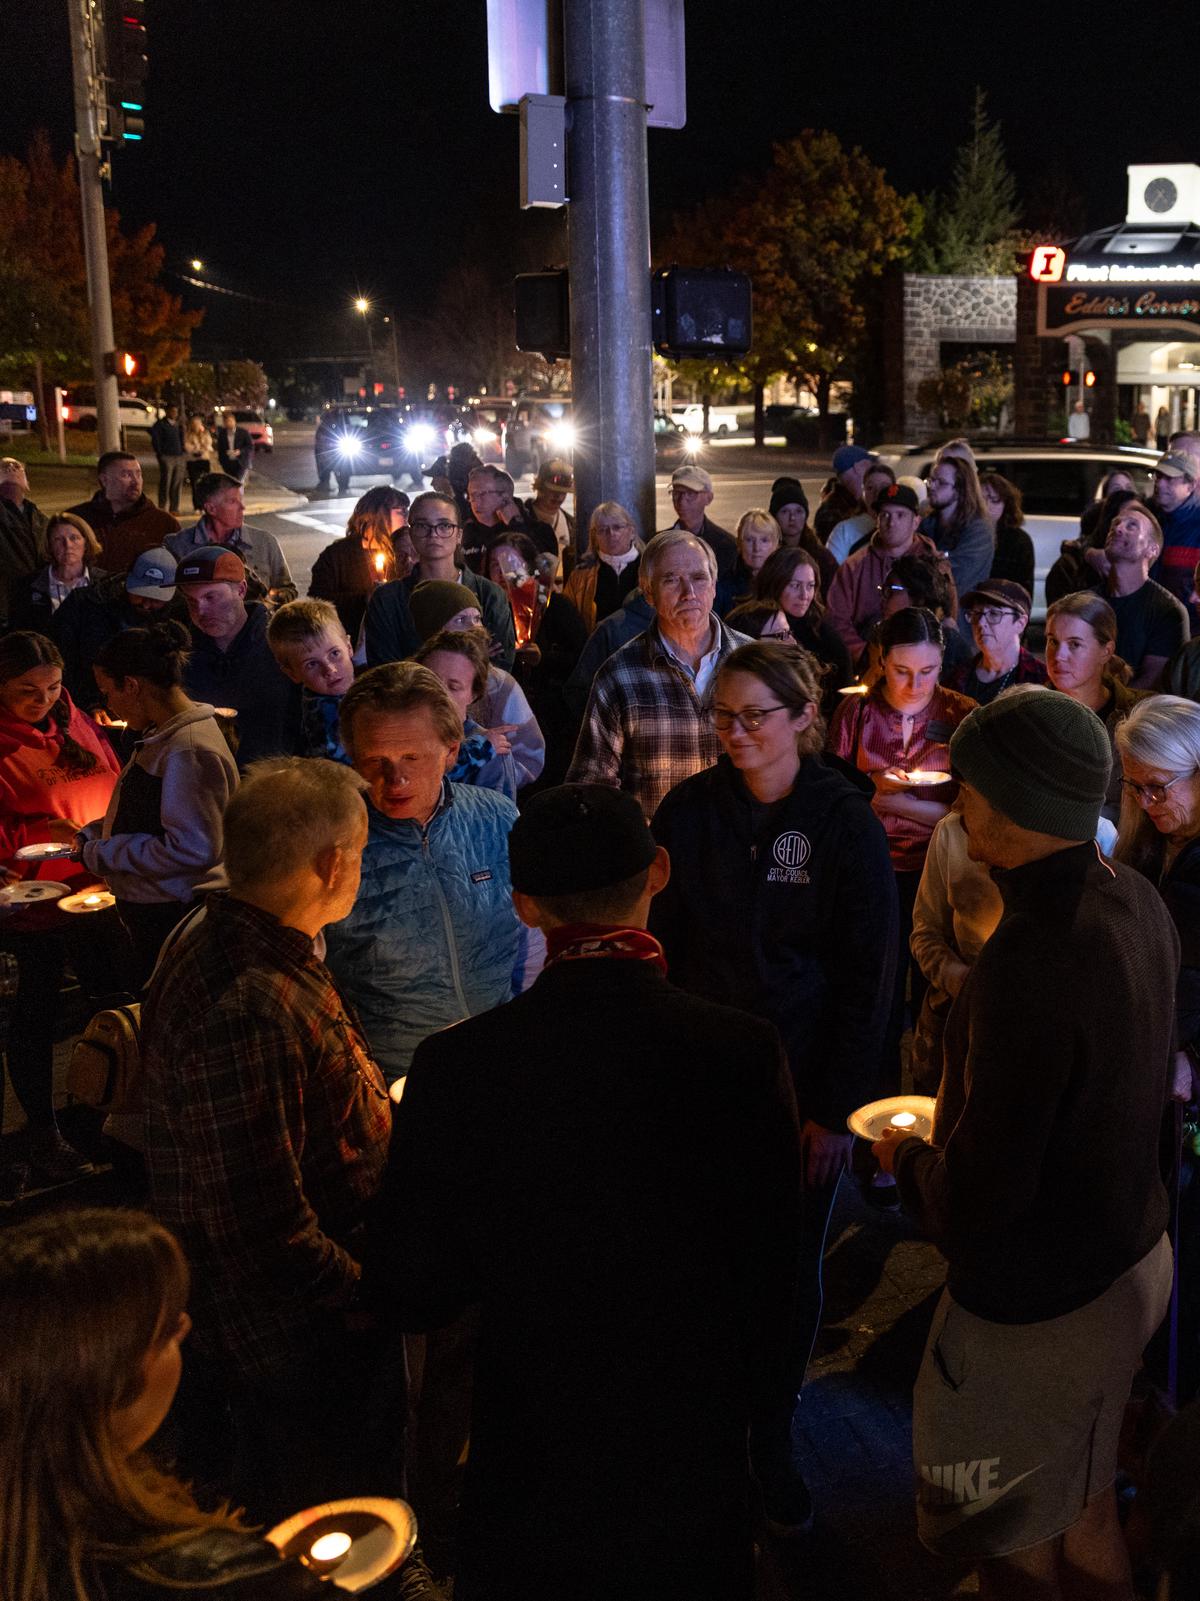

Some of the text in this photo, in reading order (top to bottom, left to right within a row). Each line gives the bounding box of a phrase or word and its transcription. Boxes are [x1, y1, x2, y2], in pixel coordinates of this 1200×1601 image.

[1064, 290, 1200, 315] Eddie's Corner
[777, 835, 807, 865] BEND
[767, 874, 788, 883] MAYOR
[769, 867, 784, 875] CITY
[920, 1456, 1001, 1503] NIKE
